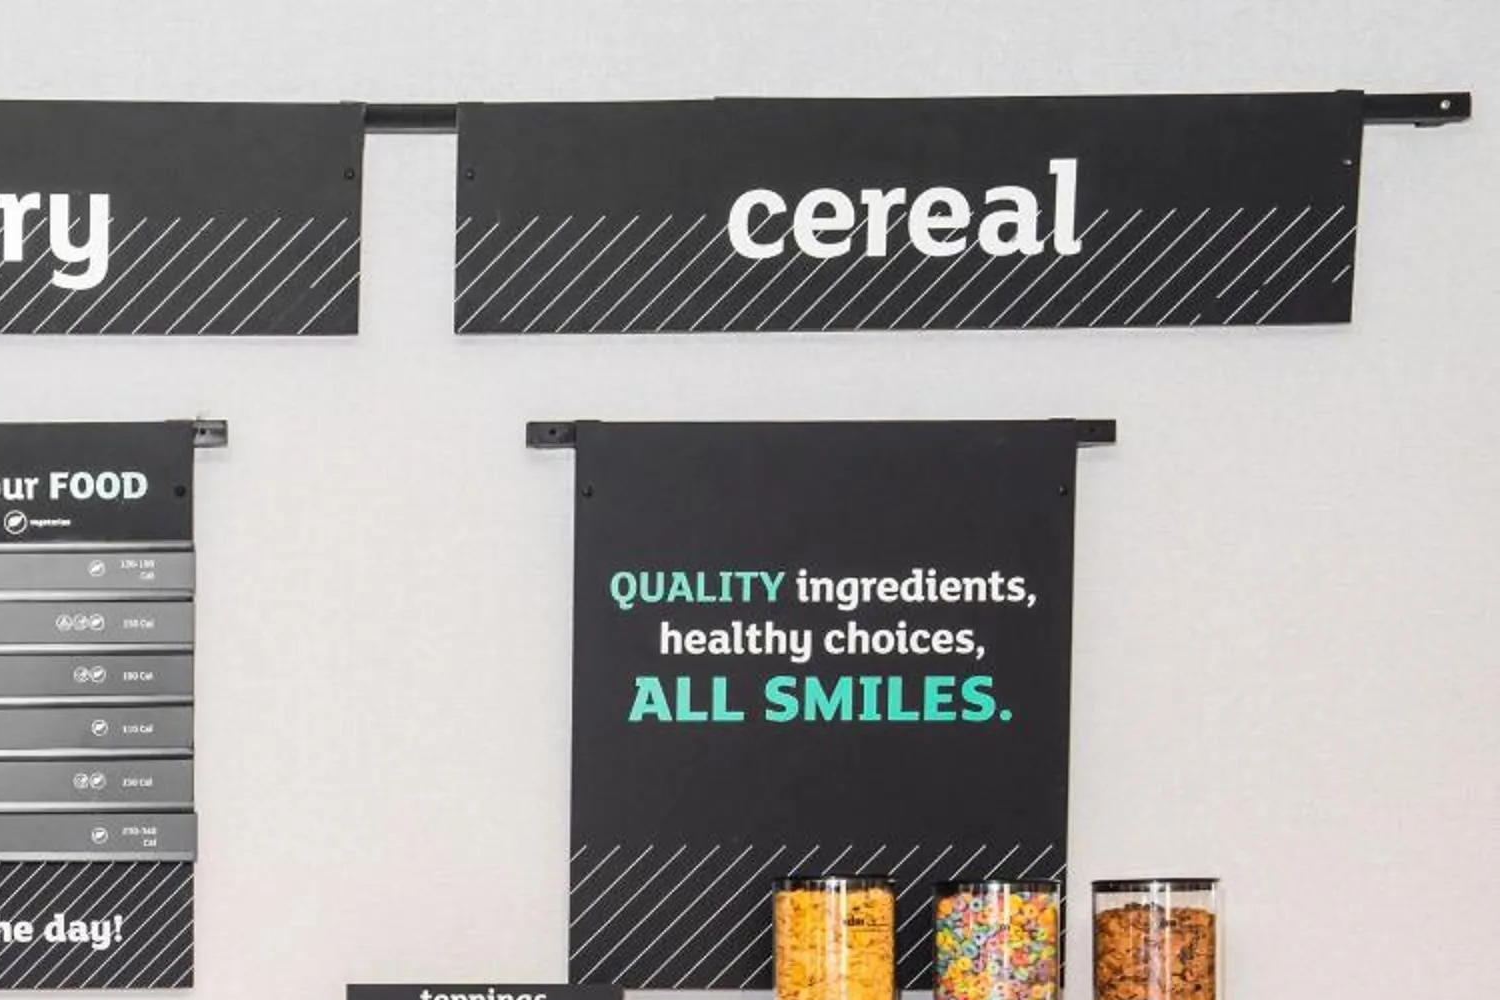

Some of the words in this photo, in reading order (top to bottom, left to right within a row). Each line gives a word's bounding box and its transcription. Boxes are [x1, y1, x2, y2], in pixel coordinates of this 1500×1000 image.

[728, 158, 1082, 259] cereal
[49, 471, 148, 500] FOOD
[610, 571, 786, 611] QUALITY
[796, 568, 1037, 611] ingredients,
[660, 621, 812, 663] healthy
[823, 621, 985, 660] choices,
[628, 676, 744, 722] ALL
[765, 675, 1013, 722] SMILES.
[44, 912, 123, 951] day!
